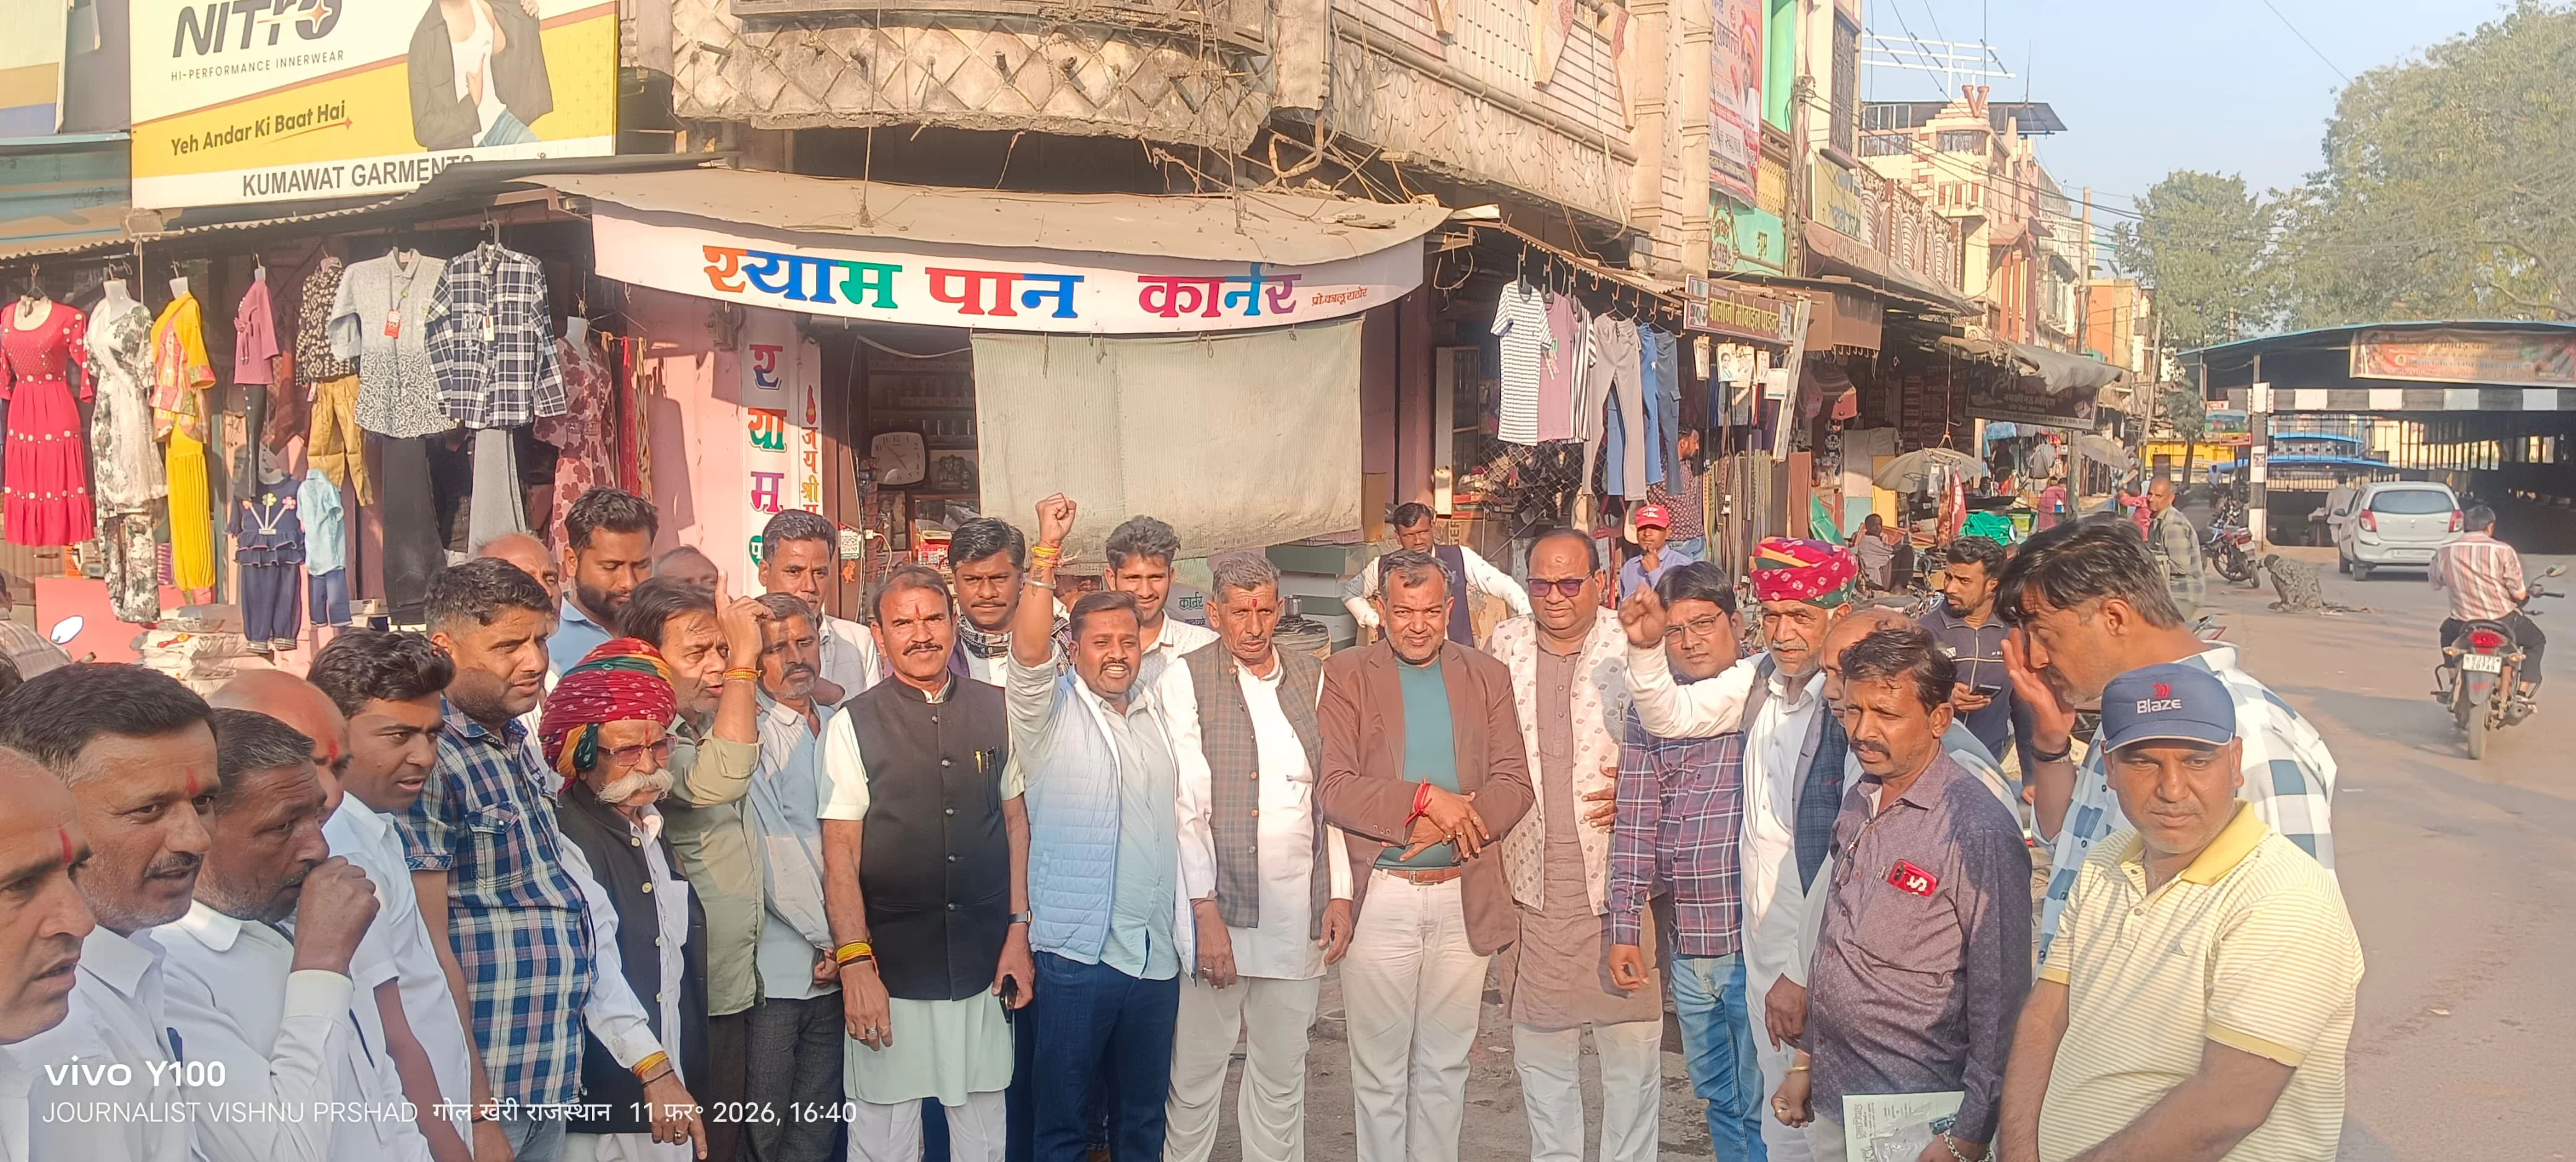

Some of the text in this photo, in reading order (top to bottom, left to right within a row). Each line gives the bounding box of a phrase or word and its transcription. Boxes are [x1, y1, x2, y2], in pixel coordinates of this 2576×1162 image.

[171, 51, 344, 82] HI-PERFORMANCE INNERWEAR
[171, 100, 346, 156] Yeh Andar Ki Baat Hai
[243, 166, 344, 197] KUMAWAT
[925, 267, 1084, 318] पान
[1138, 262, 1302, 318] कार्नर
[2137, 699, 2182, 714] Blaze
